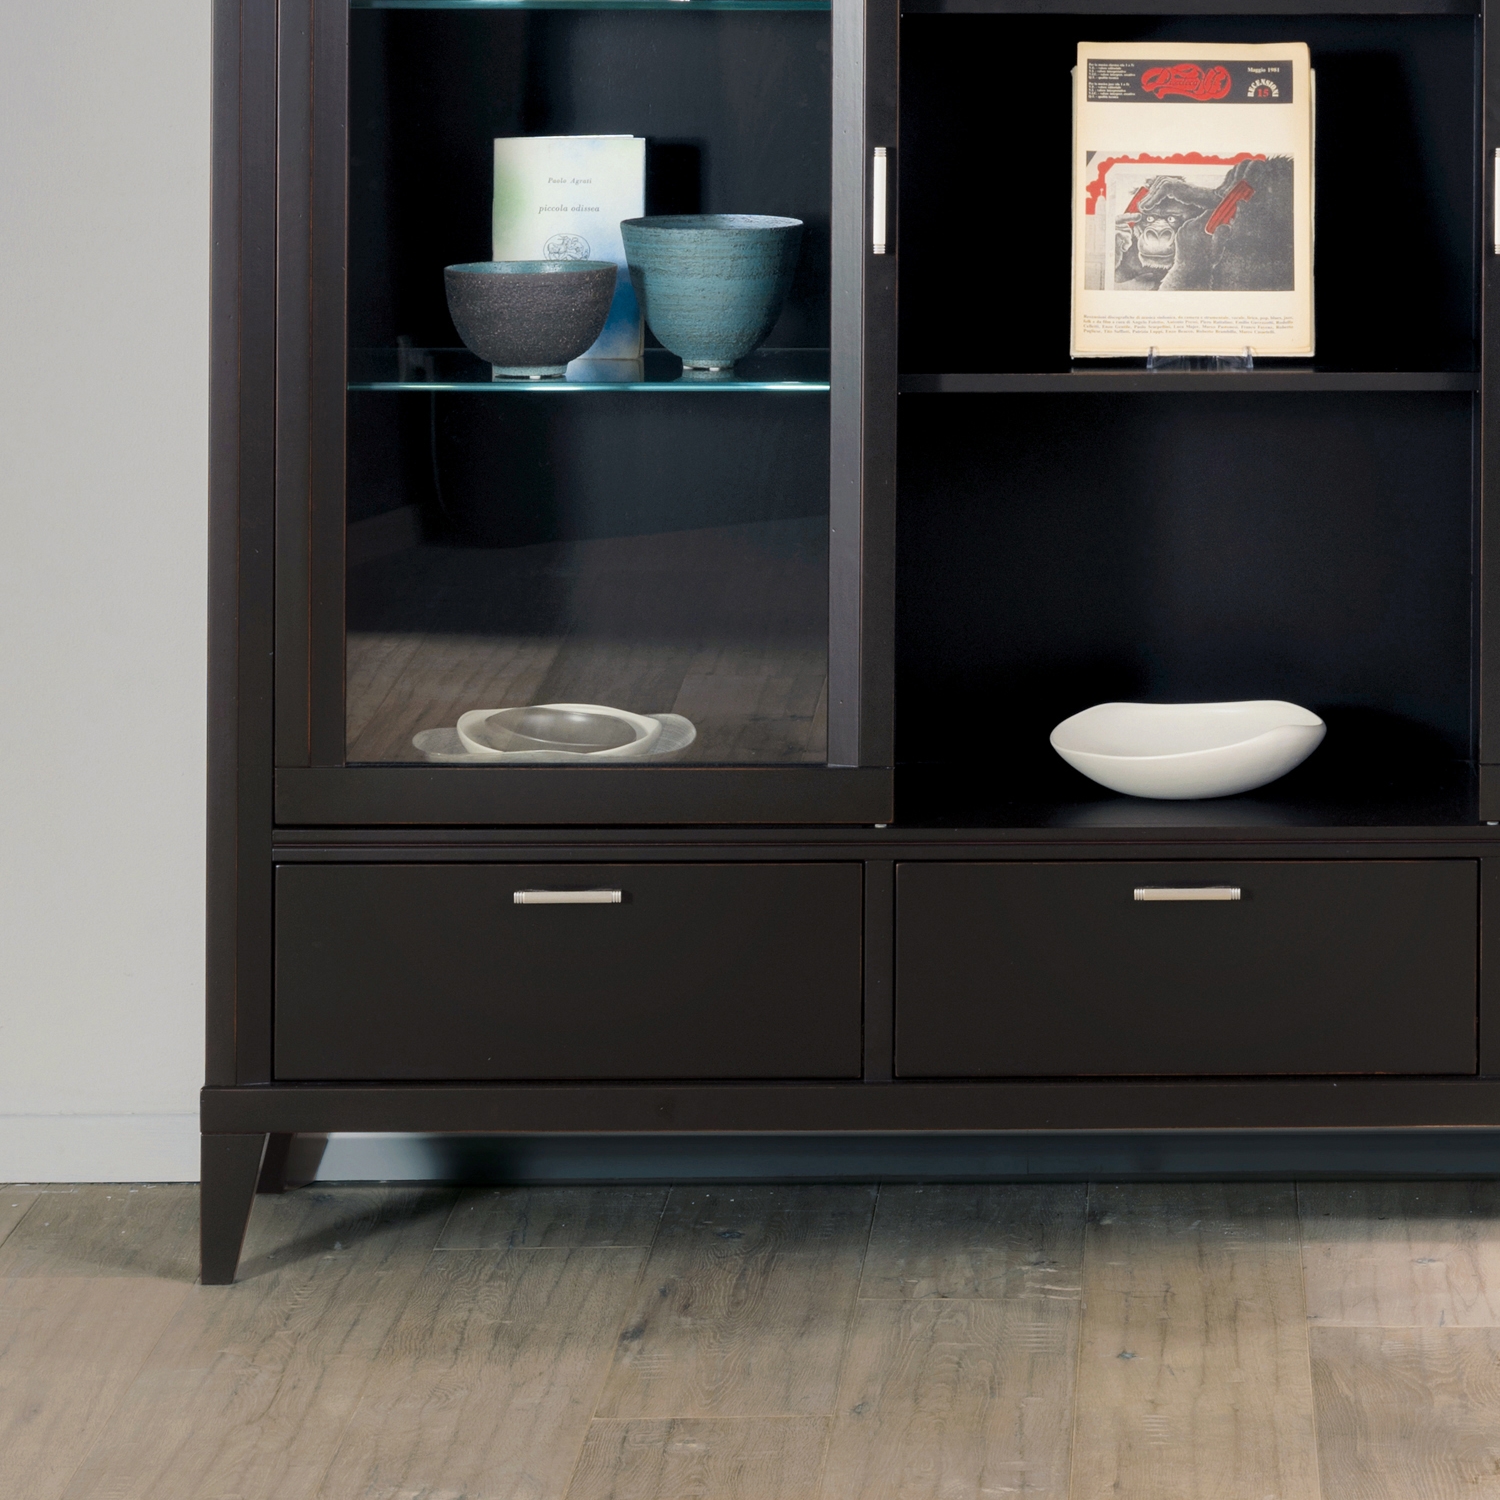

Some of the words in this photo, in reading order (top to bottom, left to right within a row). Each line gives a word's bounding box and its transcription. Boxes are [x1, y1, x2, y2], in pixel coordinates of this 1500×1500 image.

[1247, 78, 1279, 97] RECENSIONI
[1258, 88, 1269, 97] 15
[570, 177, 592, 185] Agrati
[538, 204, 568, 214] piccola
[570, 204, 600, 212] odissea
